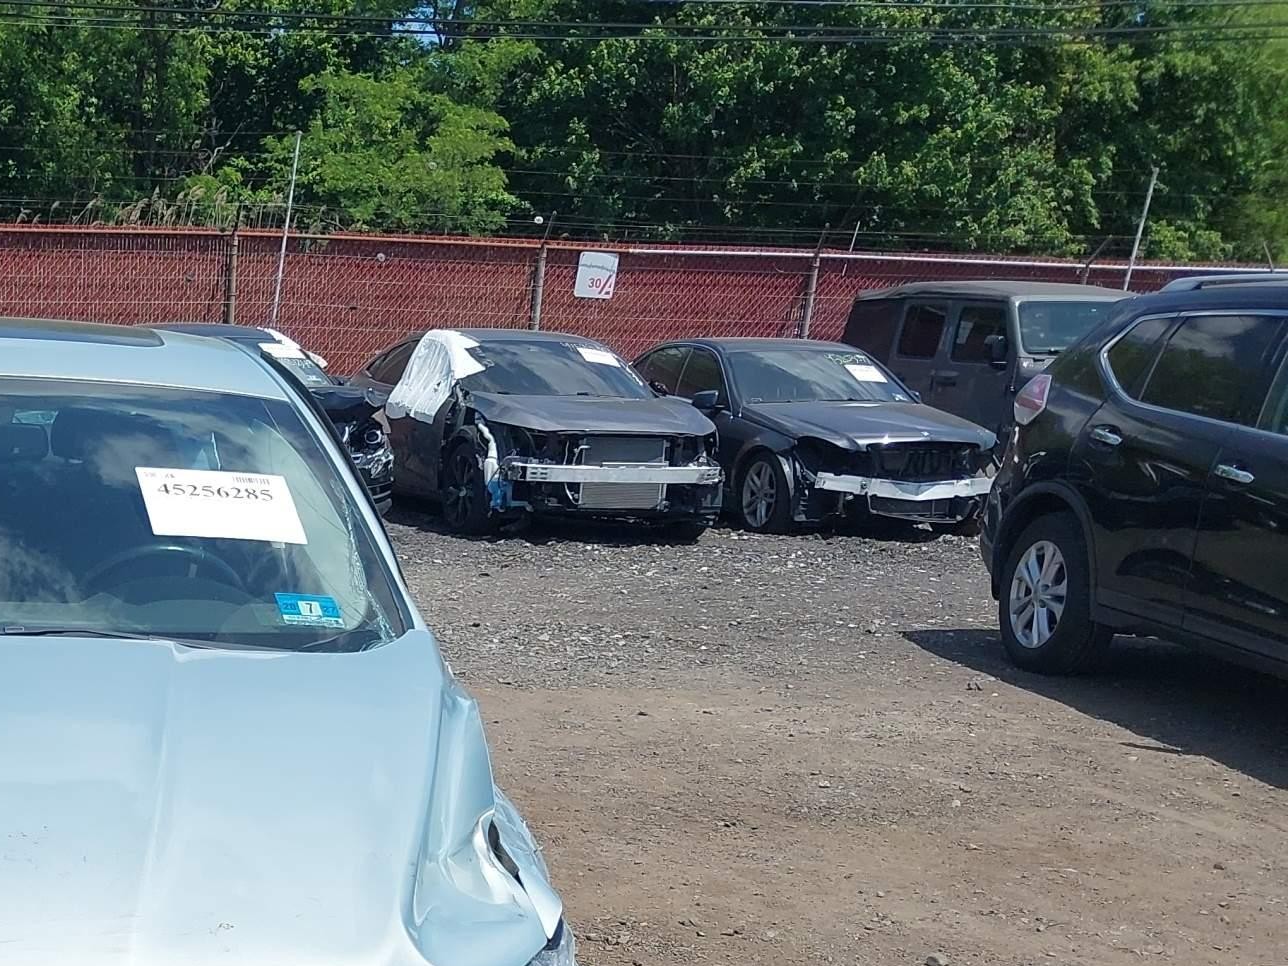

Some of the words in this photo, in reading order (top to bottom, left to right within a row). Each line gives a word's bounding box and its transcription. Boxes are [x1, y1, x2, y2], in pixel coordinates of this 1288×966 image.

[588, 277, 602, 289] 30
[157, 483, 274, 502] 45256285
[304, 602, 314, 614] 7
